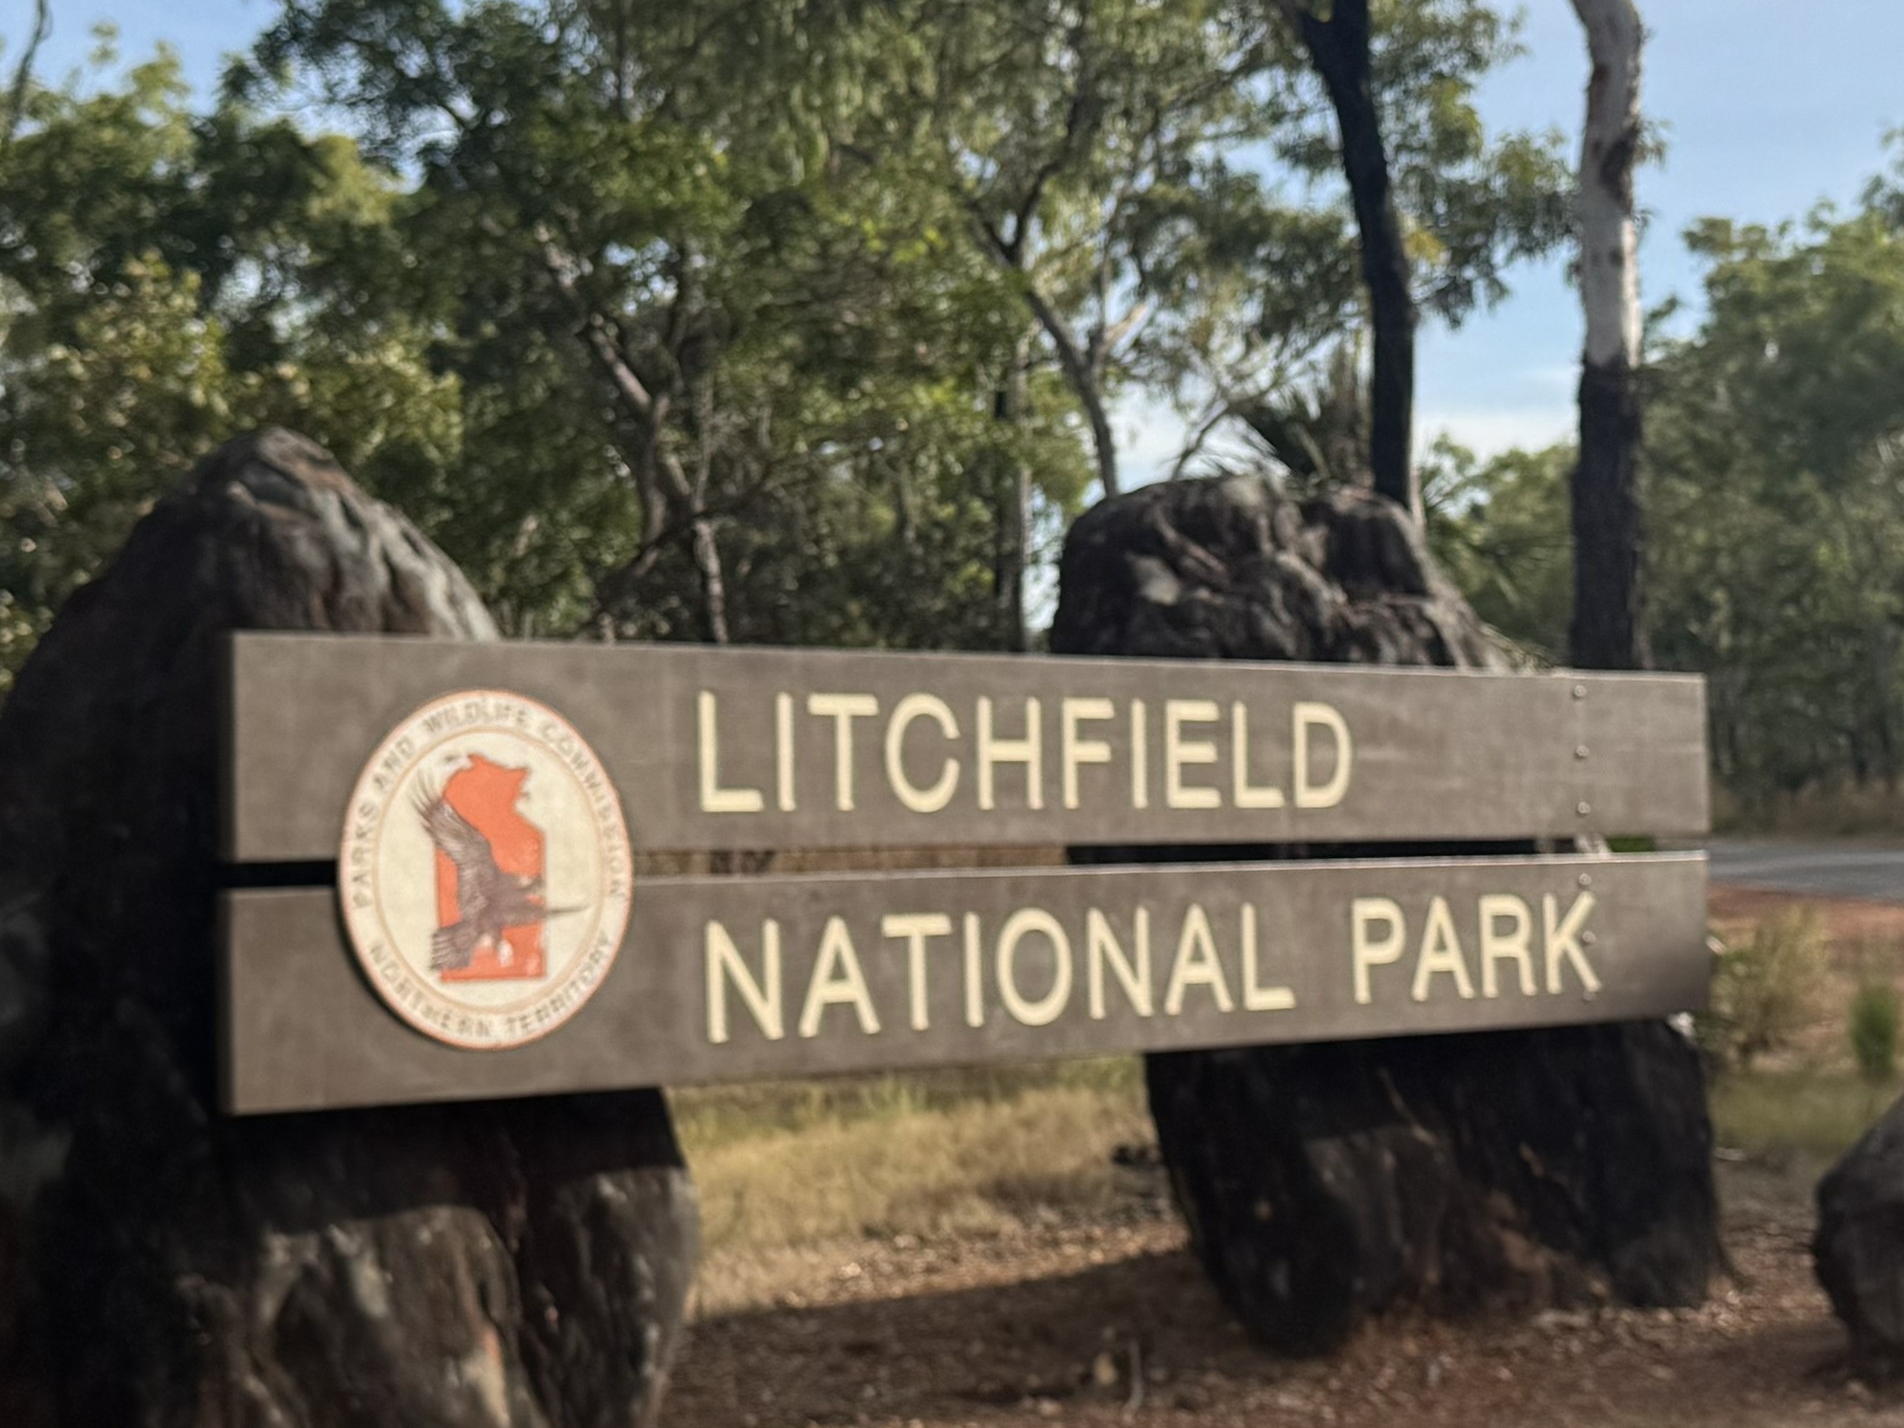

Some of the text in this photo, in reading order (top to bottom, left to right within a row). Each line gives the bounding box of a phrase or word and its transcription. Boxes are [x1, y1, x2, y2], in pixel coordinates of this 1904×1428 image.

[350, 802, 381, 909] PARKS
[373, 735, 415, 793] AND
[421, 700, 529, 735] WILDLIFE
[698, 689, 1353, 814] LITCHFIELD
[704, 890, 1602, 1044] NATIONAL PARK
